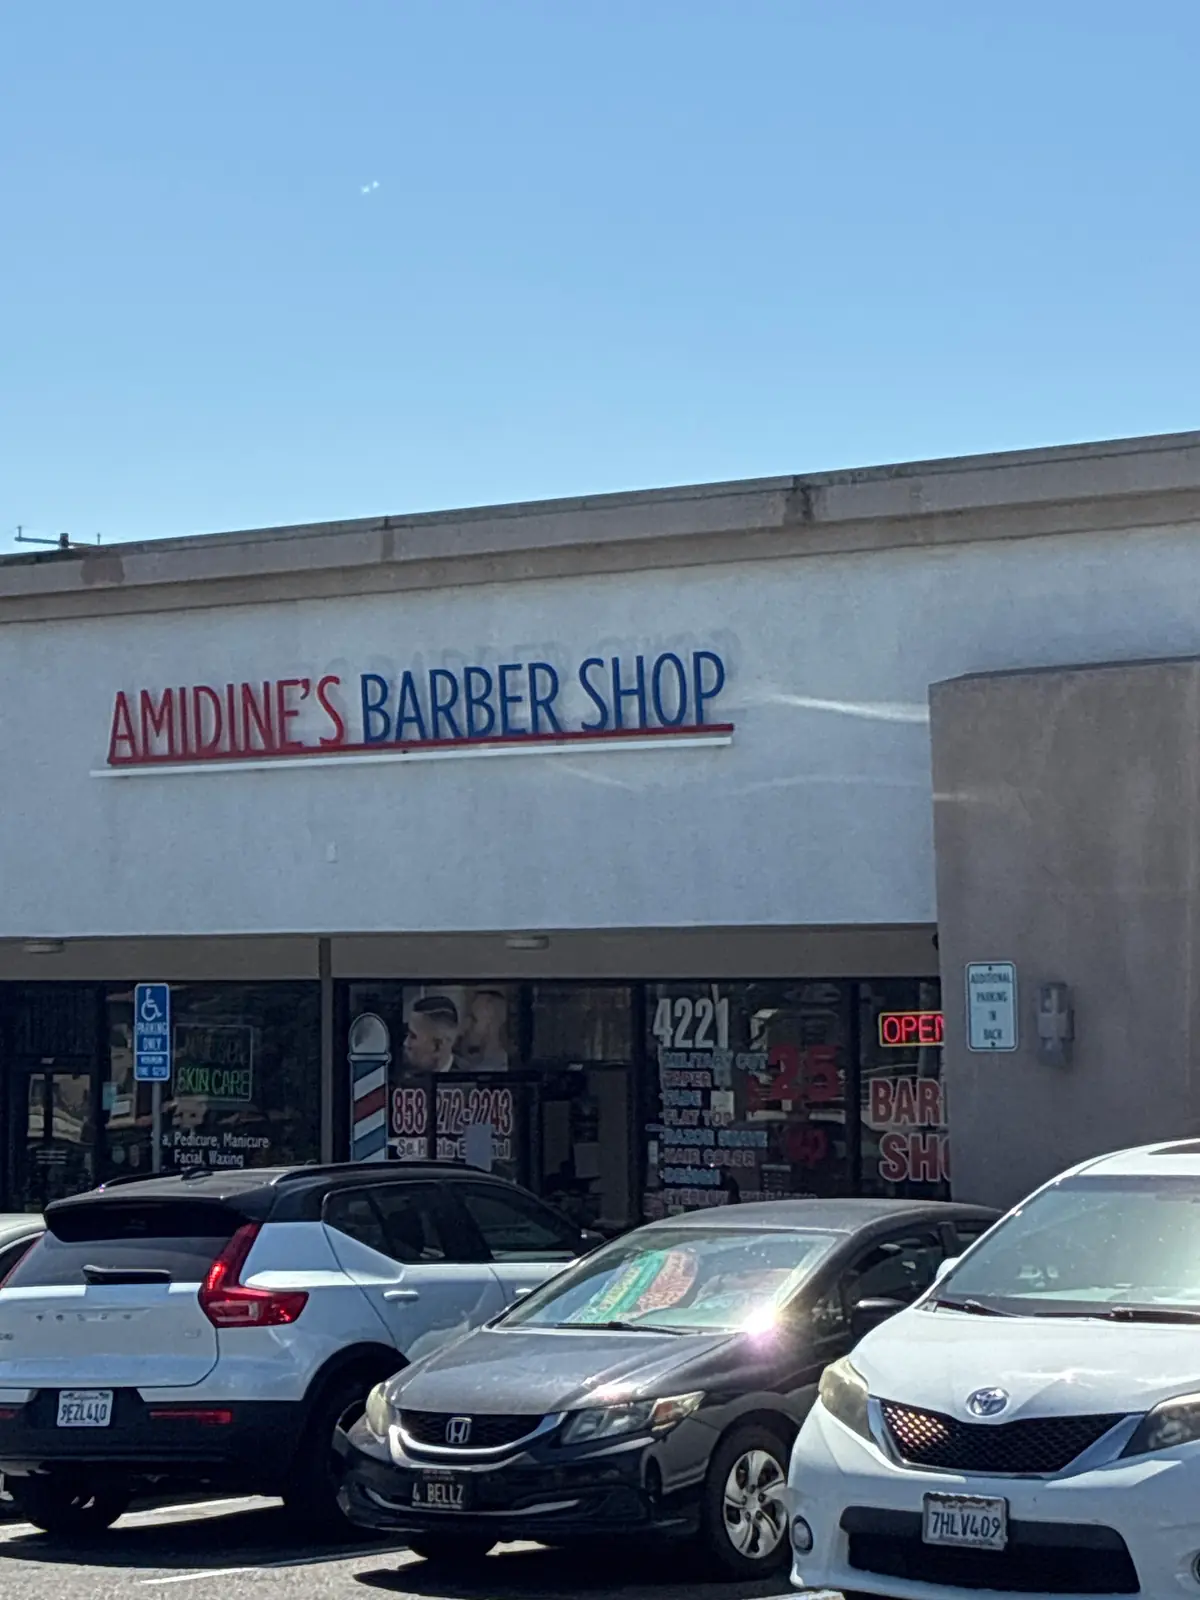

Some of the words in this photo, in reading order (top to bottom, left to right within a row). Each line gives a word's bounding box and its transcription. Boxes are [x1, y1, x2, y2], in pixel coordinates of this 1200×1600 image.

[107, 675, 345, 763] AMIDINE'S
[360, 662, 560, 744] BARBER
[578, 651, 726, 732] SHOP
[653, 997, 729, 1049] 4221
[983, 1028, 1003, 1041] BACK
[177, 1067, 210, 1093] SKIN
[211, 1069, 251, 1096] CARE
[392, 1088, 428, 1134] 858
[869, 1078, 950, 1126] BAR
[174, 1131, 220, 1149] Pedicure,
[223, 1132, 270, 1149] Manicure
[397, 1138, 414, 1156] Se
[208, 1150, 244, 1167] Waxing
[931, 1511, 1001, 1538] 7HLV409
